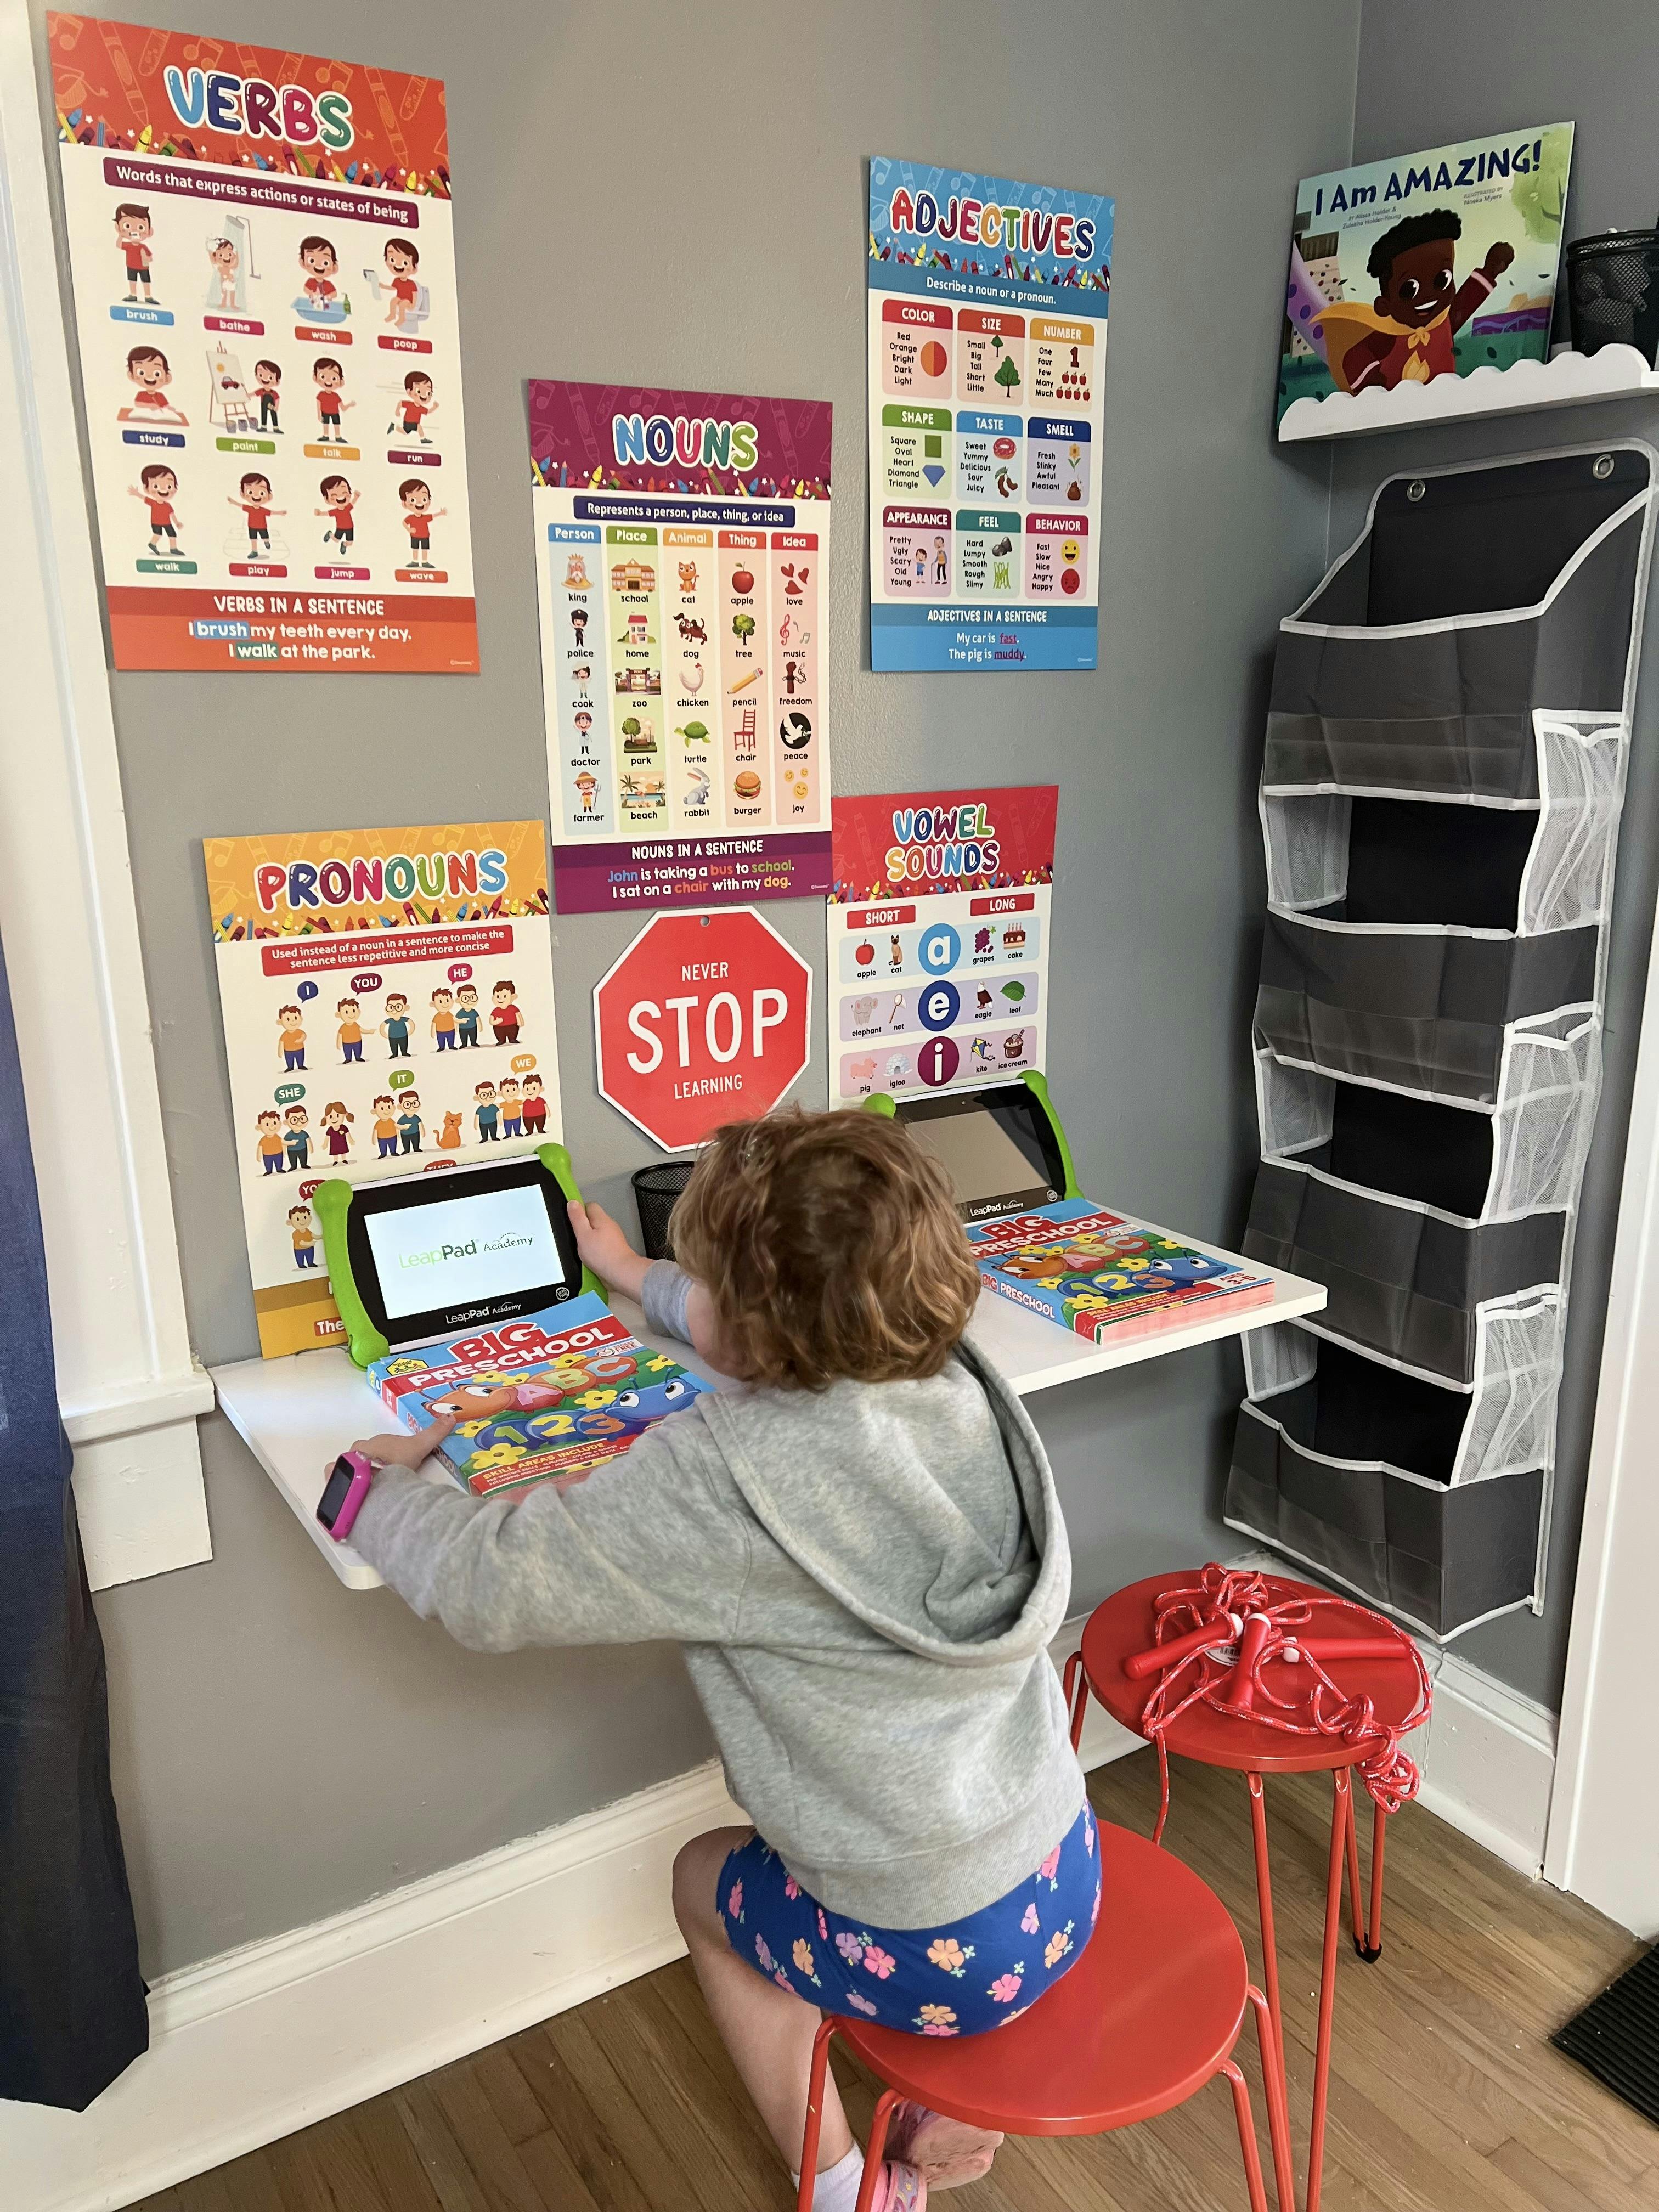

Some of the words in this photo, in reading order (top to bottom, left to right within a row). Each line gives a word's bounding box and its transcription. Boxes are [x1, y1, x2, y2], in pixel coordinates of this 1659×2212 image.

[163, 65, 356, 151] VERBS
[1315, 188, 1322, 216] I
[1330, 184, 1376, 212] Am
[1383, 139, 1542, 202] AMAZING!
[116, 165, 162, 184] Words
[165, 172, 193, 189] that
[196, 177, 247, 199] express
[250, 187, 297, 205] actions
[300, 193, 313, 206] or
[317, 195, 354, 213] states
[357, 202, 370, 214] of
[373, 204, 409, 223] being
[890, 187, 1096, 262] ADJECTIVES
[927, 276, 966, 293] Describe
[975, 286, 998, 297] noun
[1000, 289, 1009, 298] or
[1018, 290, 1056, 304] pronoun.
[126, 309, 158, 323] brush
[901, 307, 935, 323] COLOR
[219, 320, 250, 332] bathe
[981, 317, 1001, 331] SIZE
[312, 330, 337, 342] wash
[1043, 325, 1081, 340] NUMBER
[393, 340, 417, 351] poop
[901, 411, 934, 425] SHAPE
[975, 417, 1003, 430] TASTE
[1046, 424, 1074, 436] SMELL
[139, 434, 169, 447] study
[232, 441, 258, 453] paint
[612, 413, 759, 472] NOUNS
[323, 448, 342, 458] talk
[407, 454, 423, 463] run
[587, 501, 643, 517] Represents
[646, 506, 651, 516] a
[653, 506, 690, 519] person,
[692, 508, 720, 521] place,
[723, 509, 750, 523] thing,
[752, 512, 761, 521] or
[764, 511, 783, 522] idea
[887, 511, 947, 526] APPEARANCE
[979, 516, 999, 528] FEEL
[1035, 518, 1081, 531] BEHAVIOR
[555, 527, 594, 540] Person
[617, 529, 647, 543] Place
[668, 533, 707, 544] Animal
[729, 534, 757, 548] Thing
[783, 537, 806, 548] Idea
[155, 561, 179, 572] walk
[247, 565, 269, 575] play
[330, 568, 354, 579] jump
[409, 572, 433, 580] wave
[568, 593, 587, 603] king
[620, 594, 648, 602] school
[731, 597, 754, 606] apple
[213, 596, 264, 613] VERBS
[270, 597, 288, 613] IN
[293, 599, 302, 613] A
[308, 599, 384, 616] SENTENCE
[928, 610, 981, 621] ADJECTIVES
[984, 610, 994, 621] IN
[996, 611, 1002, 621] A
[1005, 610, 1047, 622] SENTENCE
[188, 621, 194, 636] I
[197, 621, 247, 636] brush
[250, 625, 275, 641] my
[280, 624, 323, 639] teeth
[326, 627, 374, 642] every
[379, 625, 411, 642] day.
[956, 633, 970, 645] My
[972, 634, 986, 644] car
[988, 634, 996, 644] is
[1000, 633, 1020, 644] fast.
[228, 643, 234, 656] I
[237, 643, 278, 658] walk
[281, 645, 297, 658] at
[301, 645, 328, 659] the
[332, 646, 375, 661] park.
[949, 649, 966, 659] The
[968, 649, 981, 662] pig
[984, 650, 992, 659] is
[994, 650, 1027, 661] muddy.
[892, 803, 995, 843] VOWEL
[631, 844, 674, 859] NOUNS
[678, 844, 691, 856] IN
[694, 843, 702, 856] A
[706, 839, 763, 855] SENTENCE
[885, 840, 1001, 883] SOUNDS
[608, 870, 638, 883] John
[641, 868, 651, 879] is
[654, 867, 697, 881] taking
[699, 866, 708, 877] a
[710, 863, 733, 876] bus
[736, 862, 749, 873] to
[752, 859, 794, 873] school.
[254, 849, 507, 914] PRONOUNS
[612, 886, 617, 898] I
[619, 886, 641, 897] sat
[643, 885, 660, 896] on
[662, 884, 672, 895] a
[674, 880, 709, 894] chair
[712, 878, 740, 891] with
[742, 878, 761, 891] my
[763, 875, 791, 889] dog.
[989, 899, 1015, 911] LONG
[865, 910, 900, 923] SHORT
[272, 947, 297, 960] Used
[300, 945, 337, 958] instead
[339, 944, 350, 953] of
[360, 943, 383, 951] noun
[387, 939, 394, 949] in
[406, 935, 448, 947] sentence
[451, 933, 460, 942] to
[462, 933, 487, 942] make
[490, 930, 504, 939] the
[927, 936, 950, 966] a
[290, 956, 336, 968] sentence
[338, 953, 357, 964] less
[359, 949, 408, 963] repetitive
[410, 946, 427, 957] and
[429, 946, 453, 955] more
[455, 941, 490, 952] concise
[972, 955, 995, 965] grapes
[453, 968, 467, 978] HE
[681, 962, 729, 981] NEVER
[857, 969, 877, 979] apple
[354, 977, 378, 989] YOU
[306, 986, 311, 996] I
[928, 990, 949, 1021] e
[627, 989, 788, 1074] STOP
[516, 1058, 531, 1068] WE
[934, 1042, 944, 1081] i
[397, 1074, 407, 1083] IT
[279, 1087, 300, 1099] SHE
[674, 1074, 743, 1099] LEARNING
[970, 1203, 1002, 1217] LeapPad
[971, 1217, 1113, 1257] PRESCHOOL
[398, 1240, 477, 1268] LeapPad
[483, 1233, 533, 1251] Academy
[1226, 1274, 1257, 1286] 3-5
[981, 1273, 998, 1291] BIG
[1000, 1284, 1056, 1318] PRESCHOOL
[445, 1306, 490, 1324] LeapPad
[492, 1302, 521, 1314] Academy
[447, 1322, 548, 1363] BIG
[408, 1327, 614, 1387] PRESCHOOL
